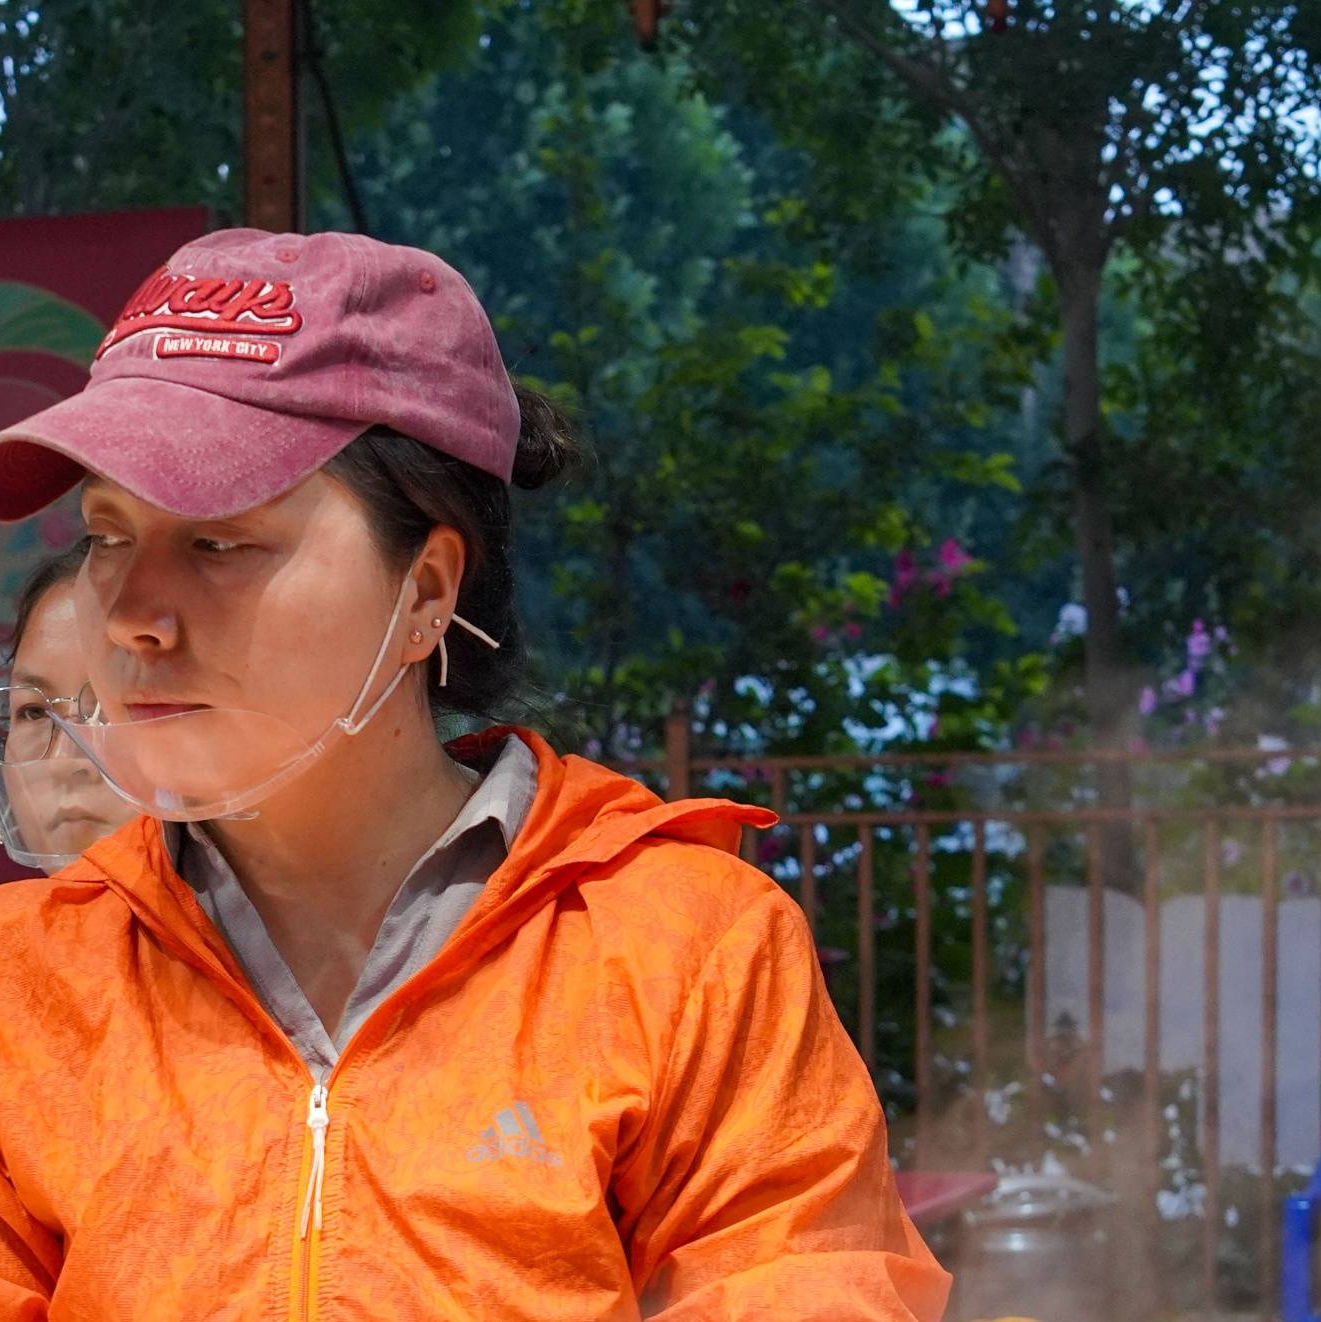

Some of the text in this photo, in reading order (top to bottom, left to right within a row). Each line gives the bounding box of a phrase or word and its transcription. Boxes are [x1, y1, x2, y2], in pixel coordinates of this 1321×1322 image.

[163, 337, 269, 357] NEW YORK CITY
[466, 1133, 564, 1169] adidas
